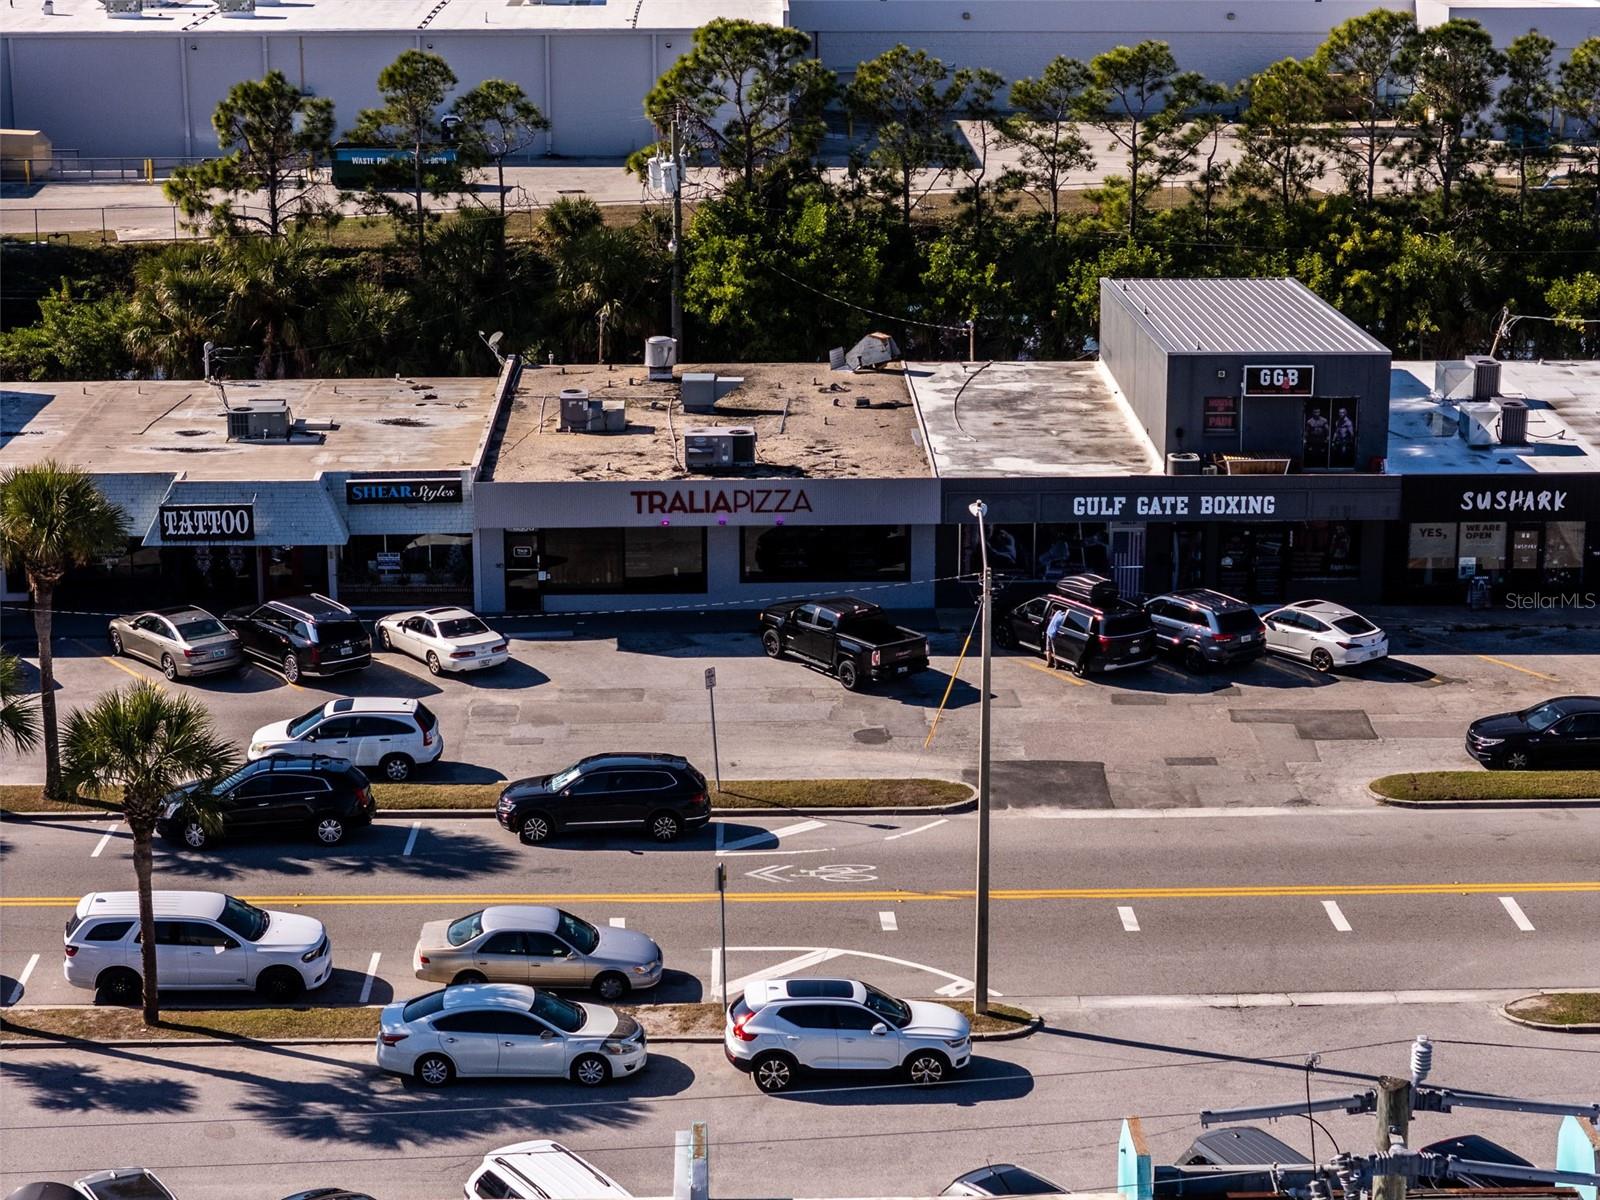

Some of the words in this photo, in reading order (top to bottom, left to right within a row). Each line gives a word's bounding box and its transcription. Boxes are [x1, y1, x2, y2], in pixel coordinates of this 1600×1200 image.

[351, 156, 375, 165] WASTE
[352, 485, 412, 500] SHEAR
[412, 484, 456, 502] Styles
[1460, 489, 1568, 512] SUSHARK
[1073, 496, 1126, 516] GULF
[1137, 496, 1189, 515] GATE
[1200, 495, 1276, 515] BOXING
[163, 509, 249, 536] TATTOO
[1419, 527, 1448, 540] YES,
[1465, 531, 1492, 540] OPEN
